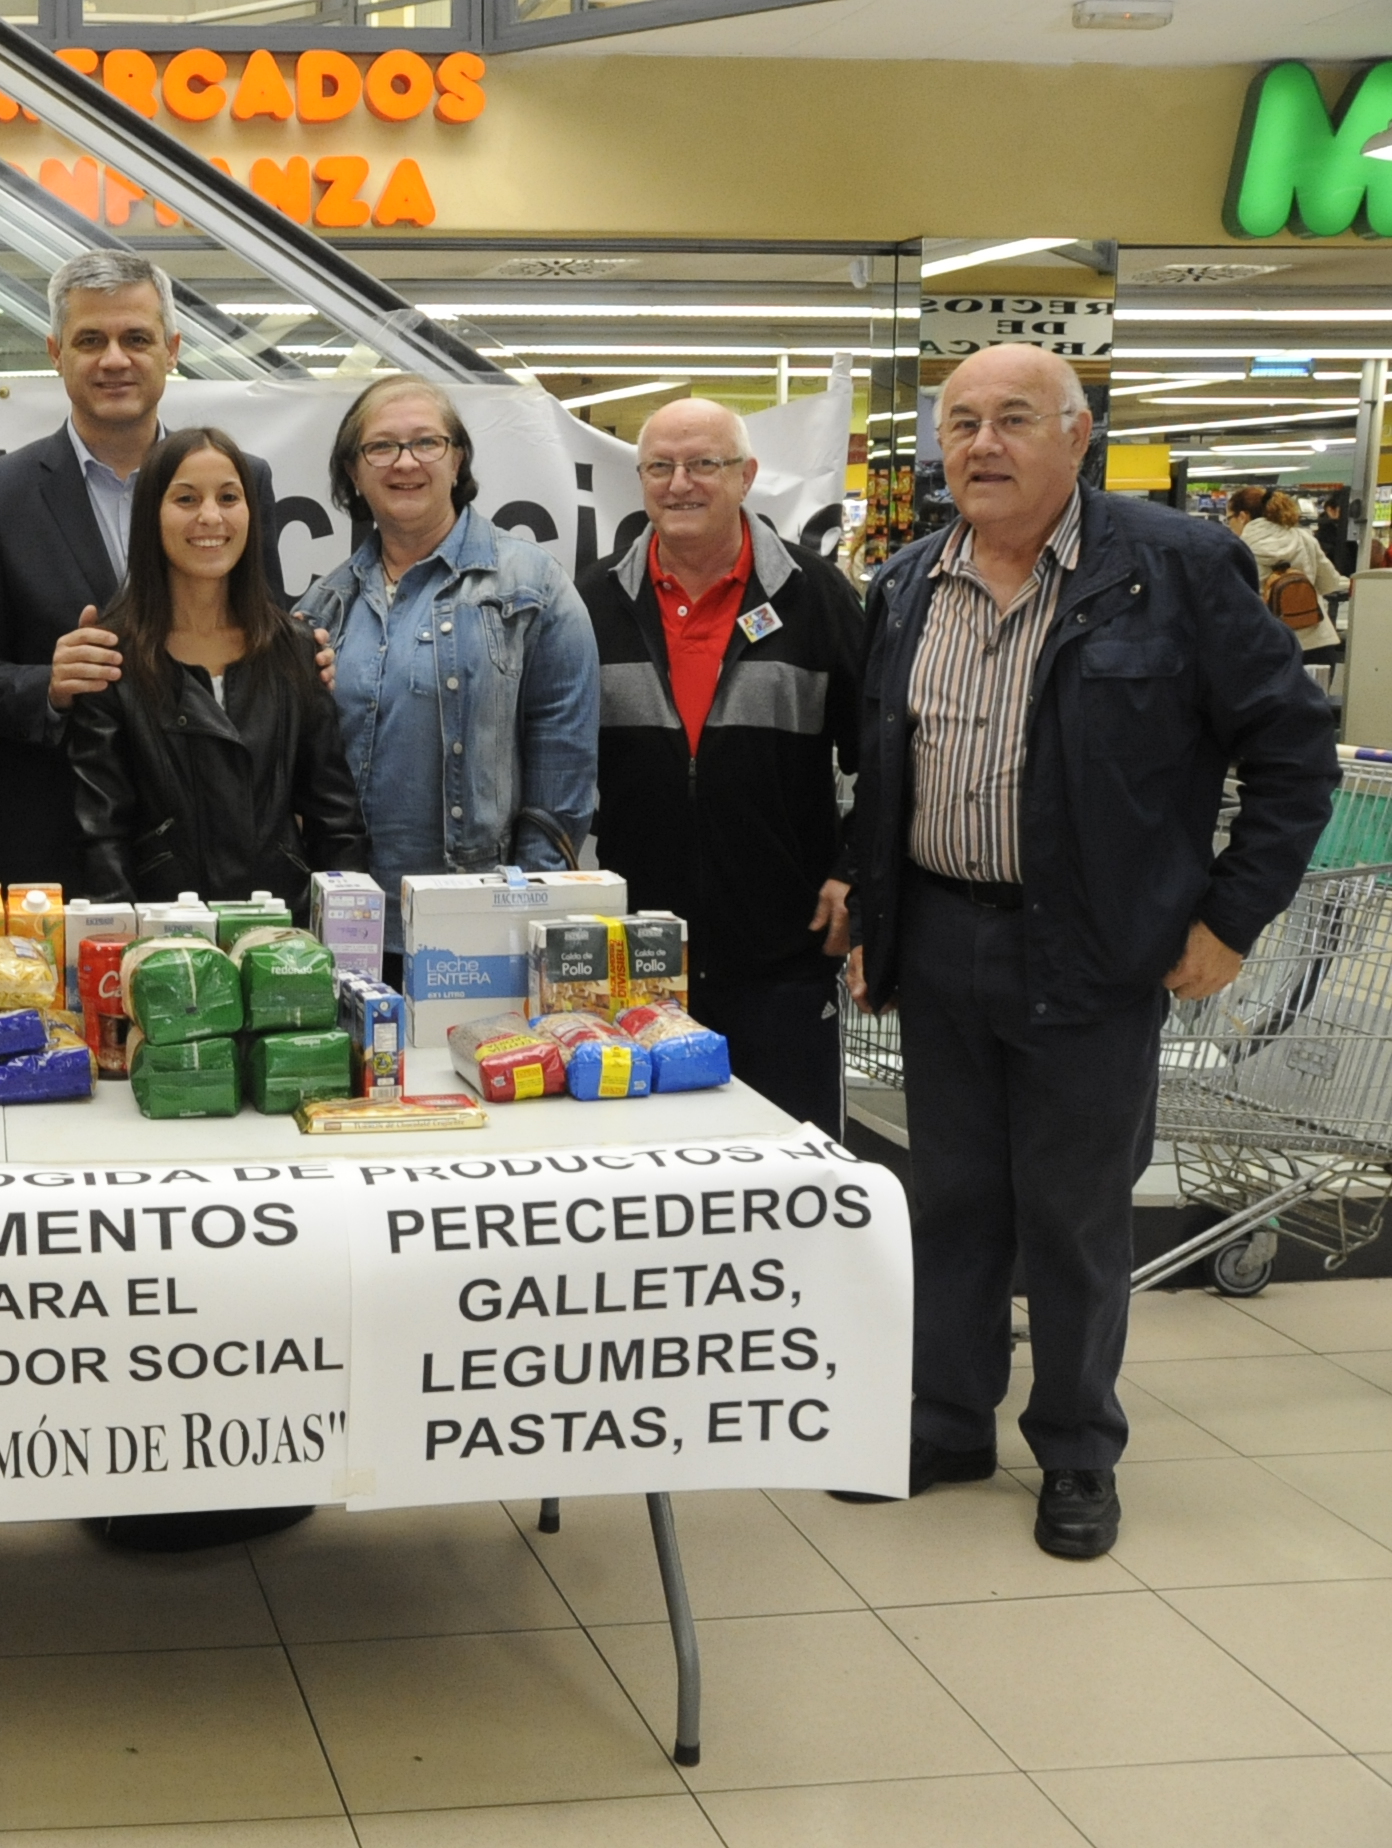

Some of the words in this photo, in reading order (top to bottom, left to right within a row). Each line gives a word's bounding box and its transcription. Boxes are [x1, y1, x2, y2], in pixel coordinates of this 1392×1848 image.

[427, 959, 479, 973] Leche
[427, 972, 492, 987] ENTERA
[562, 962, 593, 976] Pollo
[635, 959, 666, 973] Pollo
[233, 1164, 336, 1182] DE
[359, 1146, 765, 1186] PRODUCTOS
[387, 1184, 872, 1254] PERECEDEROS
[127, 1277, 198, 1316] EL
[458, 1258, 802, 1322] GALLETAS,
[129, 1337, 344, 1382] SOCIAL
[422, 1327, 837, 1394] LEGUMBRES,
[425, 1405, 683, 1461] PASTAS,
[708, 1398, 830, 1444] ETC
